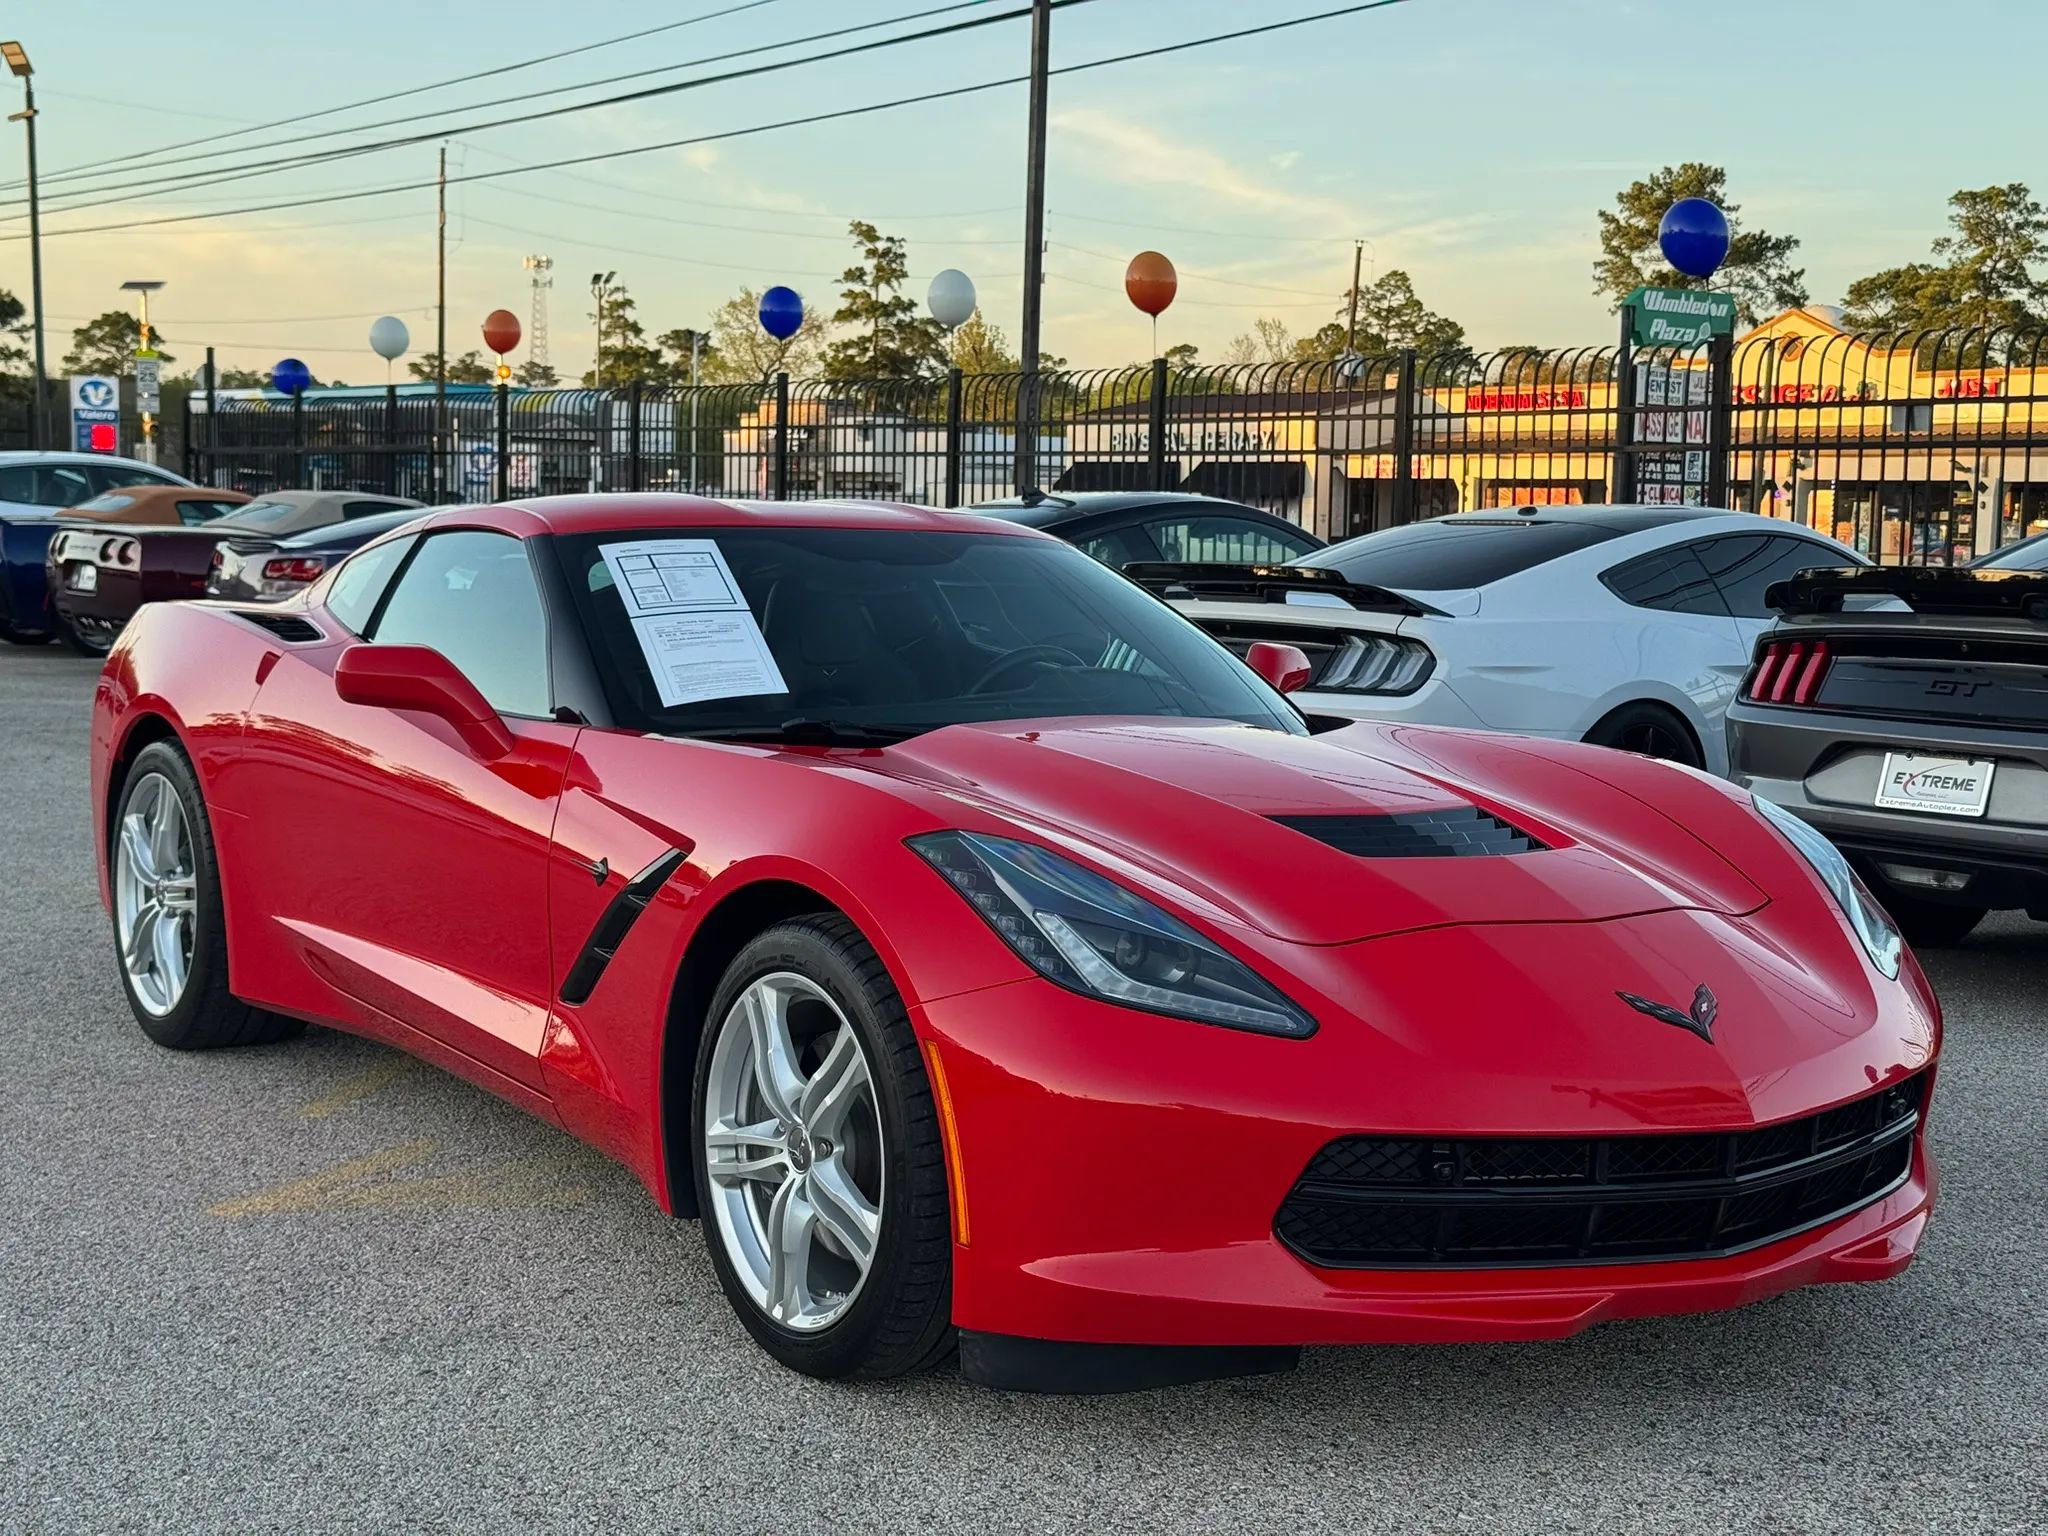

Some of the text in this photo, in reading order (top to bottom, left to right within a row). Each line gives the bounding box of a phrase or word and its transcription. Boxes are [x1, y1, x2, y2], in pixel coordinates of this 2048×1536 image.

[1643, 290, 1729, 317] Wimbledon
[1649, 318, 1697, 342] Plaza
[1647, 379, 1682, 394] ENTST
[78, 410, 116, 421] Valero
[1638, 411, 1679, 437] MASSGE
[1111, 432, 1189, 451] PHYSAL
[1648, 486, 1681, 502] CLICA
[1925, 679, 1992, 697] GT
[1893, 771, 1977, 792] EXTREME
[1878, 798, 1979, 814] ExtremeAutoplex.com
